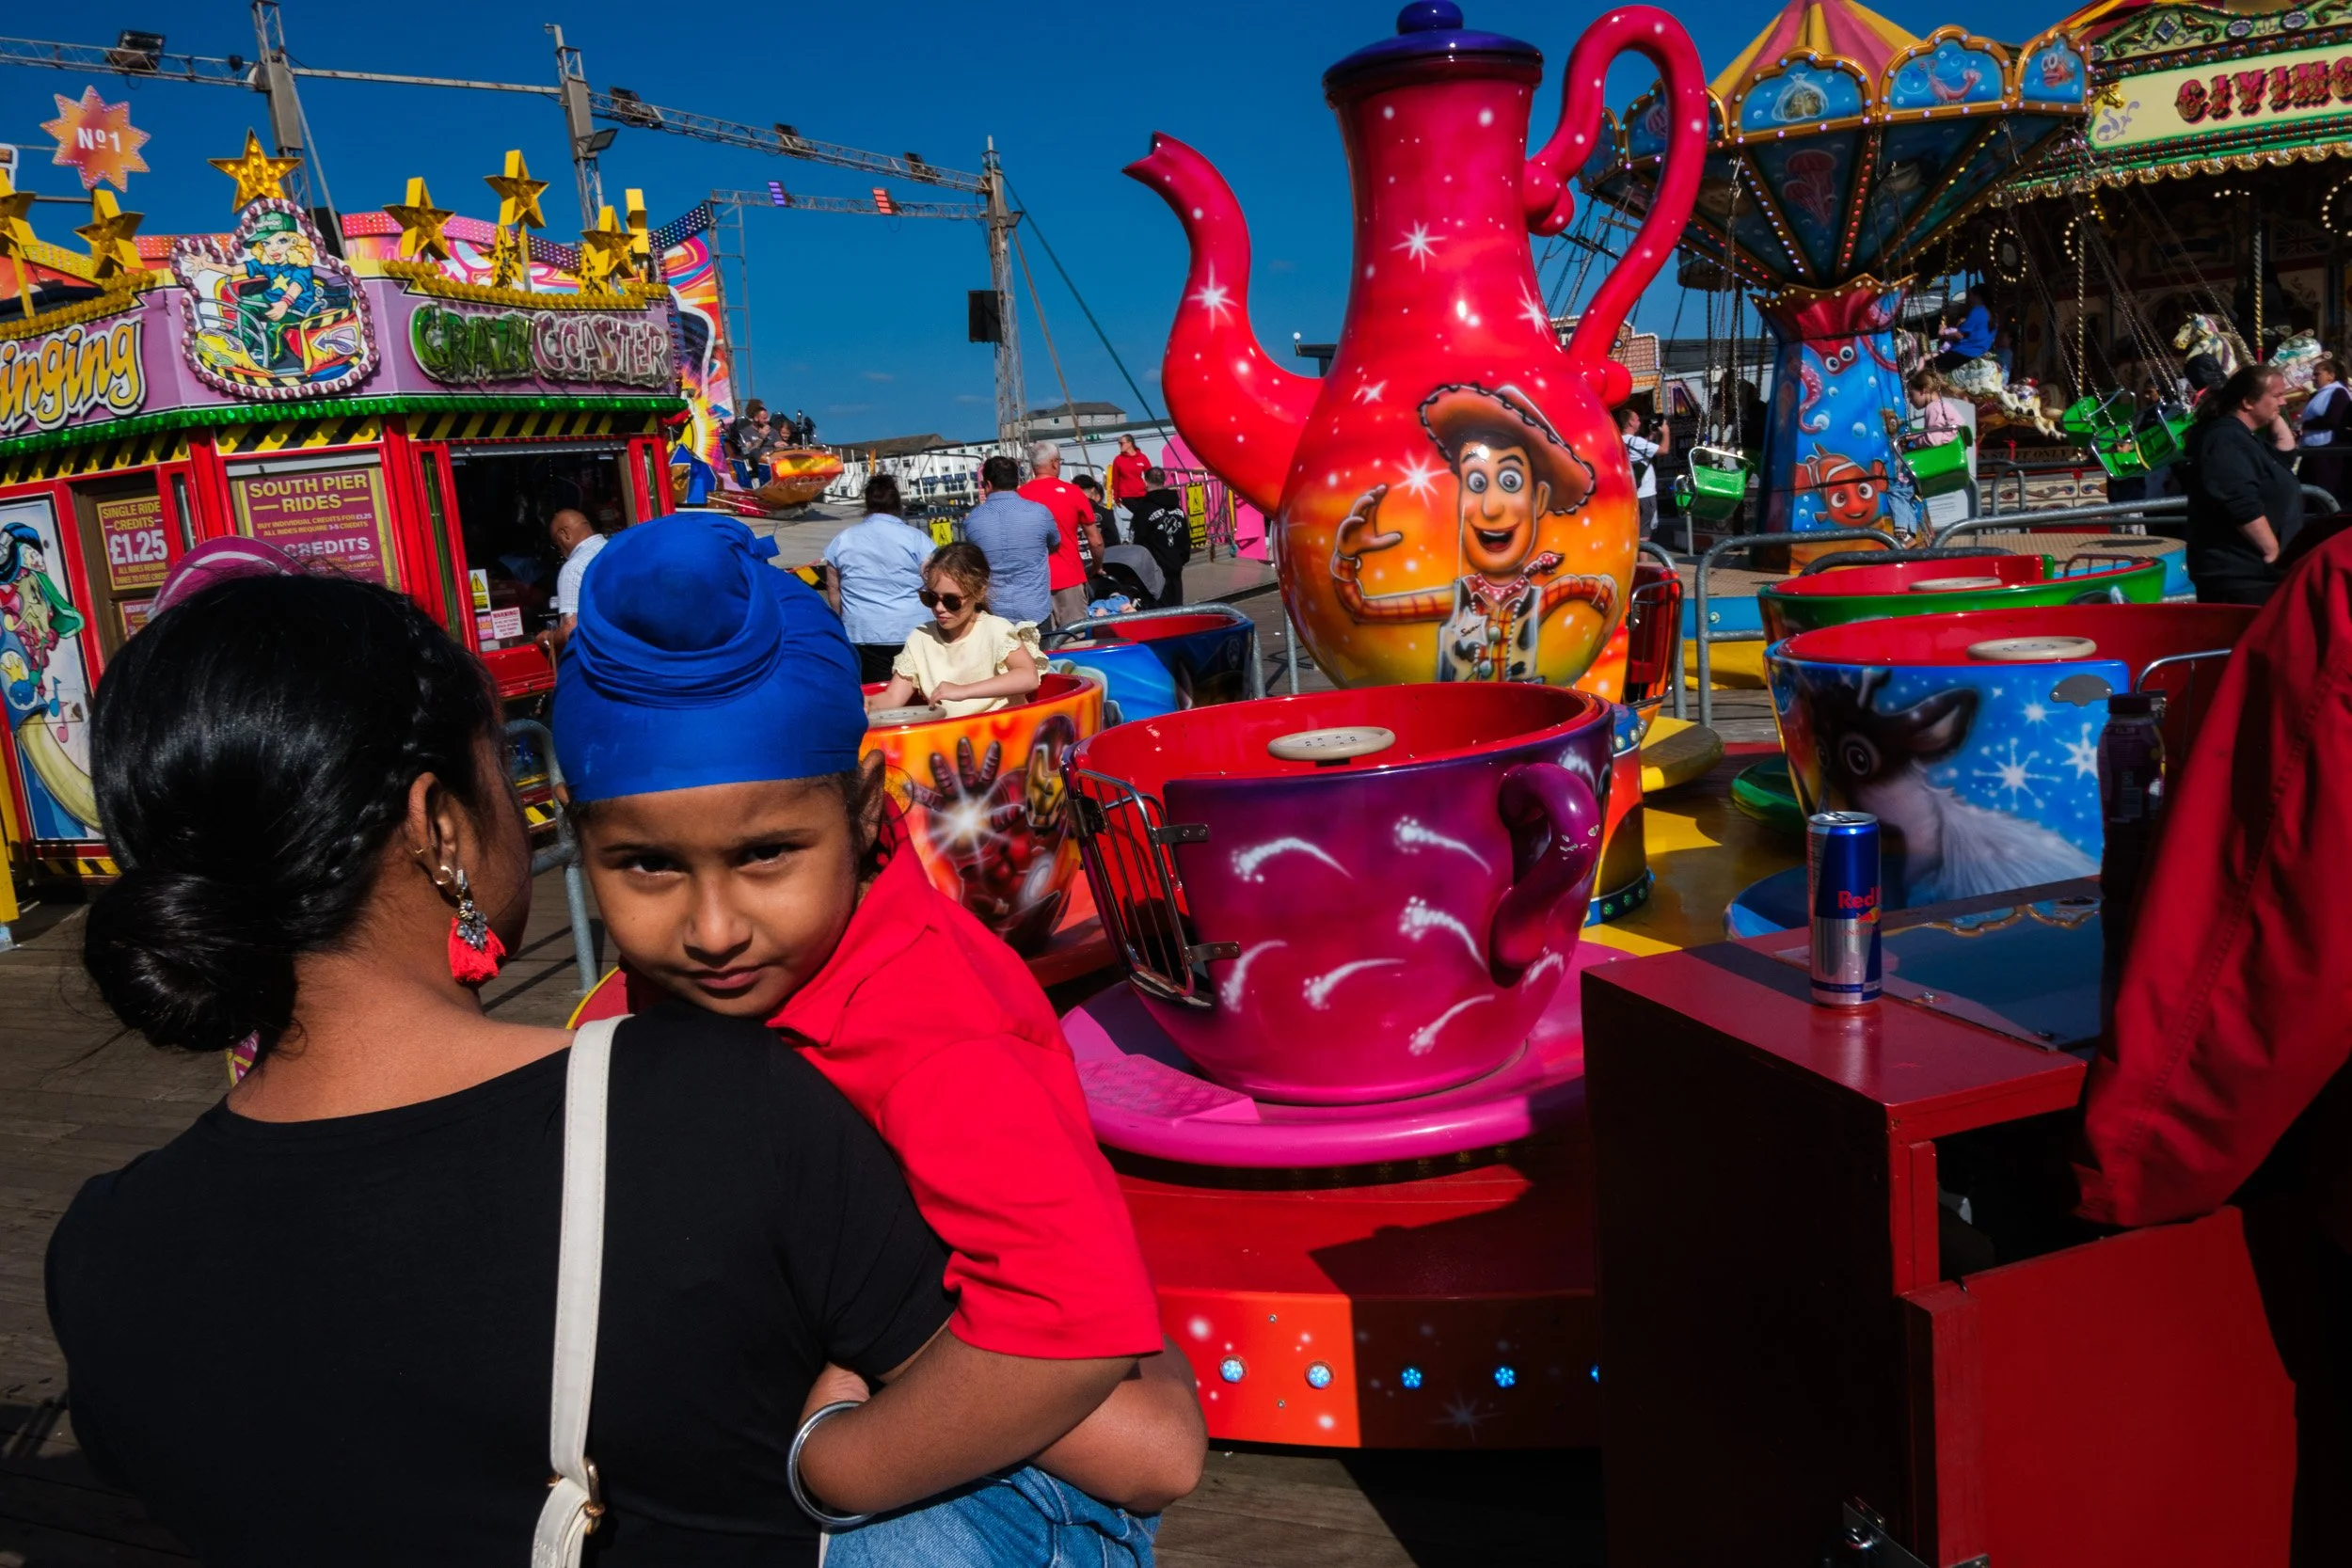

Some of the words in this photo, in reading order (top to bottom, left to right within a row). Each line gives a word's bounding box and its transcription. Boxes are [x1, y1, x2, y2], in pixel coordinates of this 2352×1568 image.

[410, 303, 533, 382] CRAZY
[532, 311, 669, 387] COASTER
[248, 478, 319, 499] SOUTH
[322, 474, 368, 491] PIER
[102, 504, 137, 519] SINGLE
[137, 501, 161, 515] RIDE
[281, 494, 342, 513] RIDES
[113, 516, 155, 531] CREDITS
[109, 530, 168, 564] £1.25
[283, 537, 371, 557] CREDITS
[1837, 887, 1875, 910] Red
